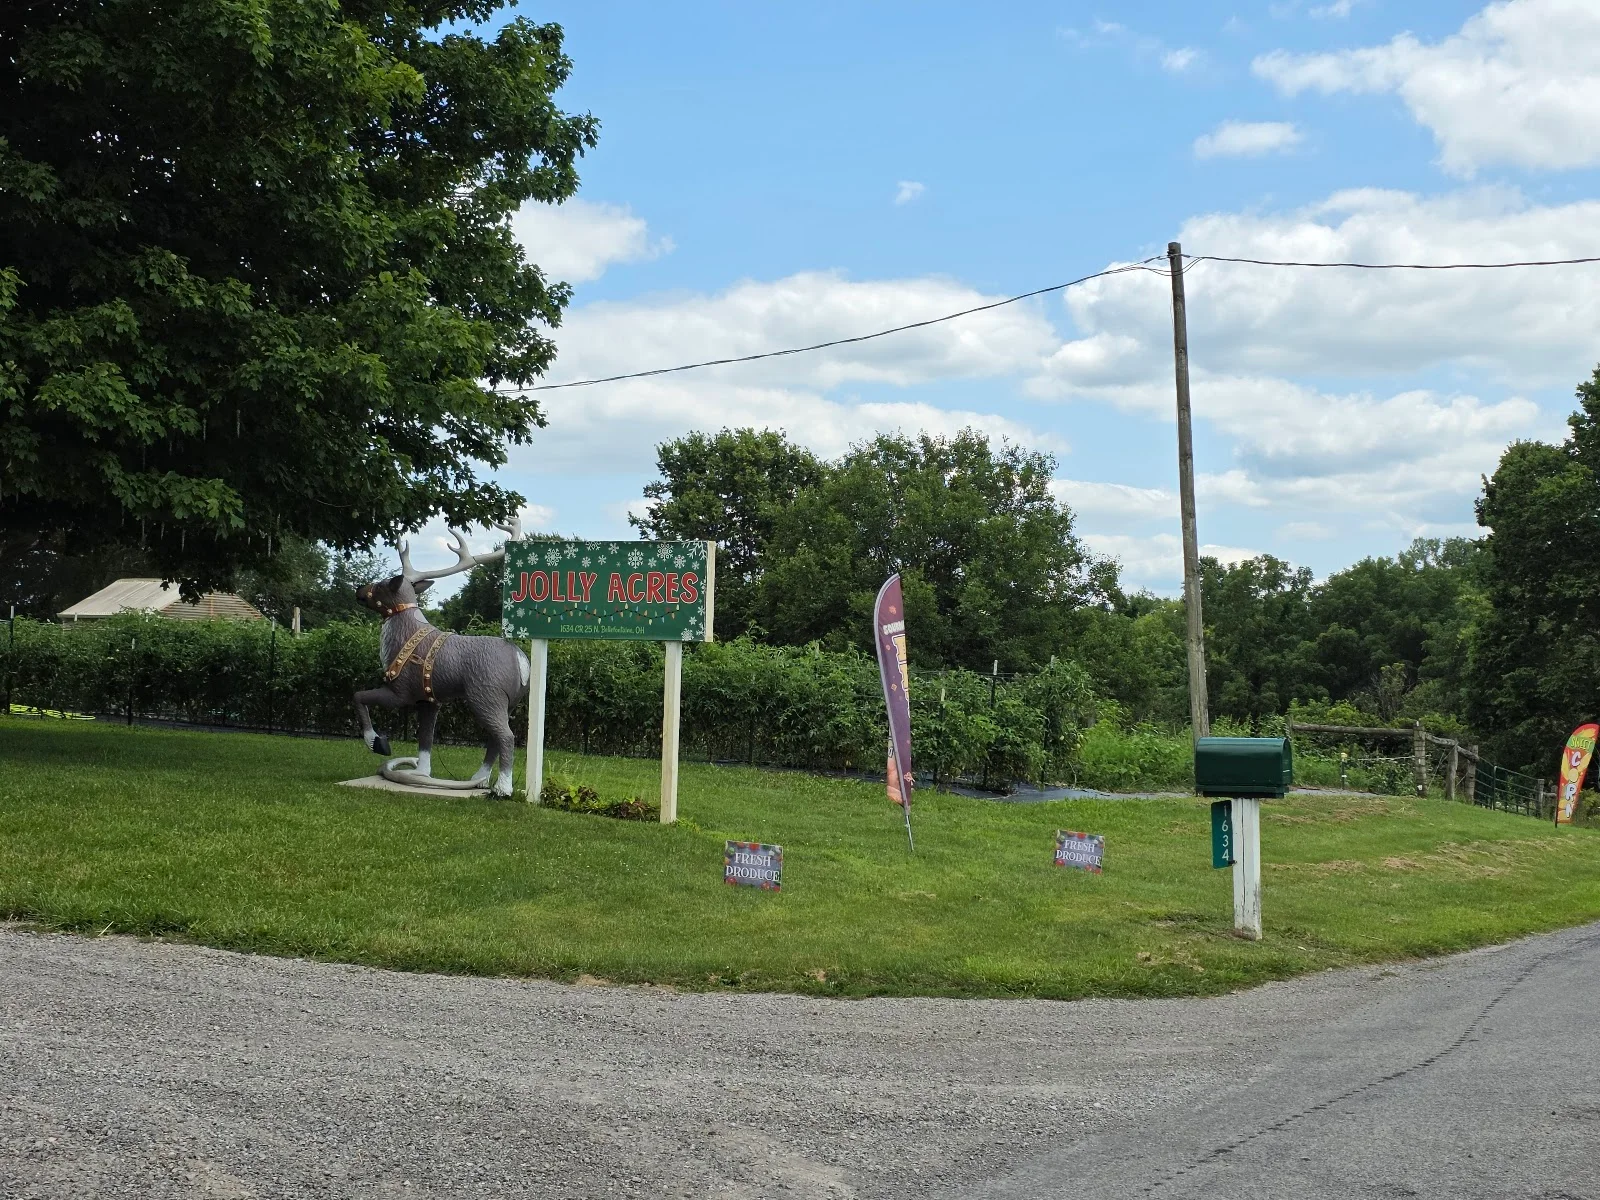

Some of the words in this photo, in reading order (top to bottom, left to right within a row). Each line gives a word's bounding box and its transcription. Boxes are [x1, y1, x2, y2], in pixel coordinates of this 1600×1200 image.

[511, 570, 598, 602] JOLLY
[607, 571, 699, 604] ACRES
[560, 624, 574, 633] 1634
[574, 624, 584, 633] CR
[584, 624, 593, 633] 25
[635, 626, 645, 634] OH
[1221, 805, 1229, 861] 1634
[1064, 839, 1095, 853] FRESH
[735, 852, 771, 867] FRESH
[1055, 849, 1101, 866] PRODUCE
[725, 865, 780, 882] PRODUCE
